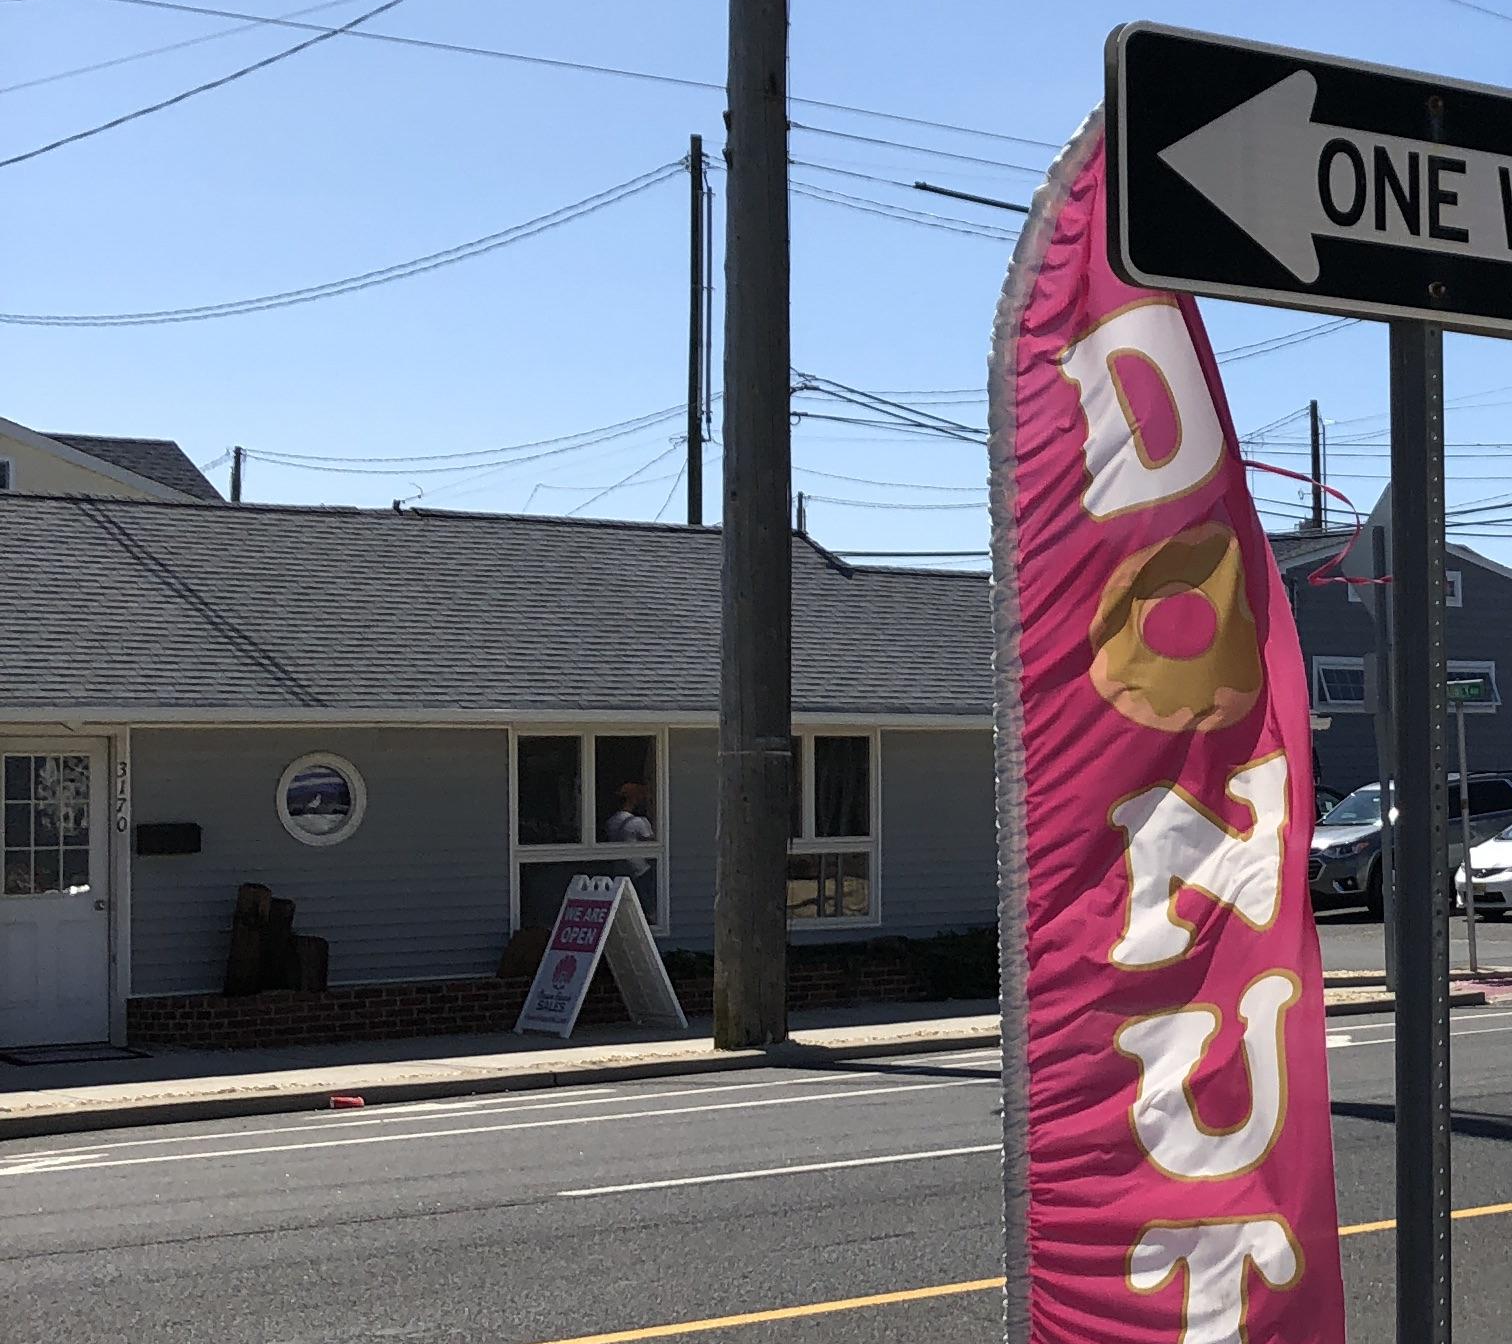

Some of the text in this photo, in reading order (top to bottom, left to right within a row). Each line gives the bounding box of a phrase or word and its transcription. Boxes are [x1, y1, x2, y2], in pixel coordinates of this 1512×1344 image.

[1317, 137, 1471, 244] ONE
[116, 761, 128, 833] 3170
[560, 926, 597, 945] OPEN
[564, 907, 608, 923] WE ARE
